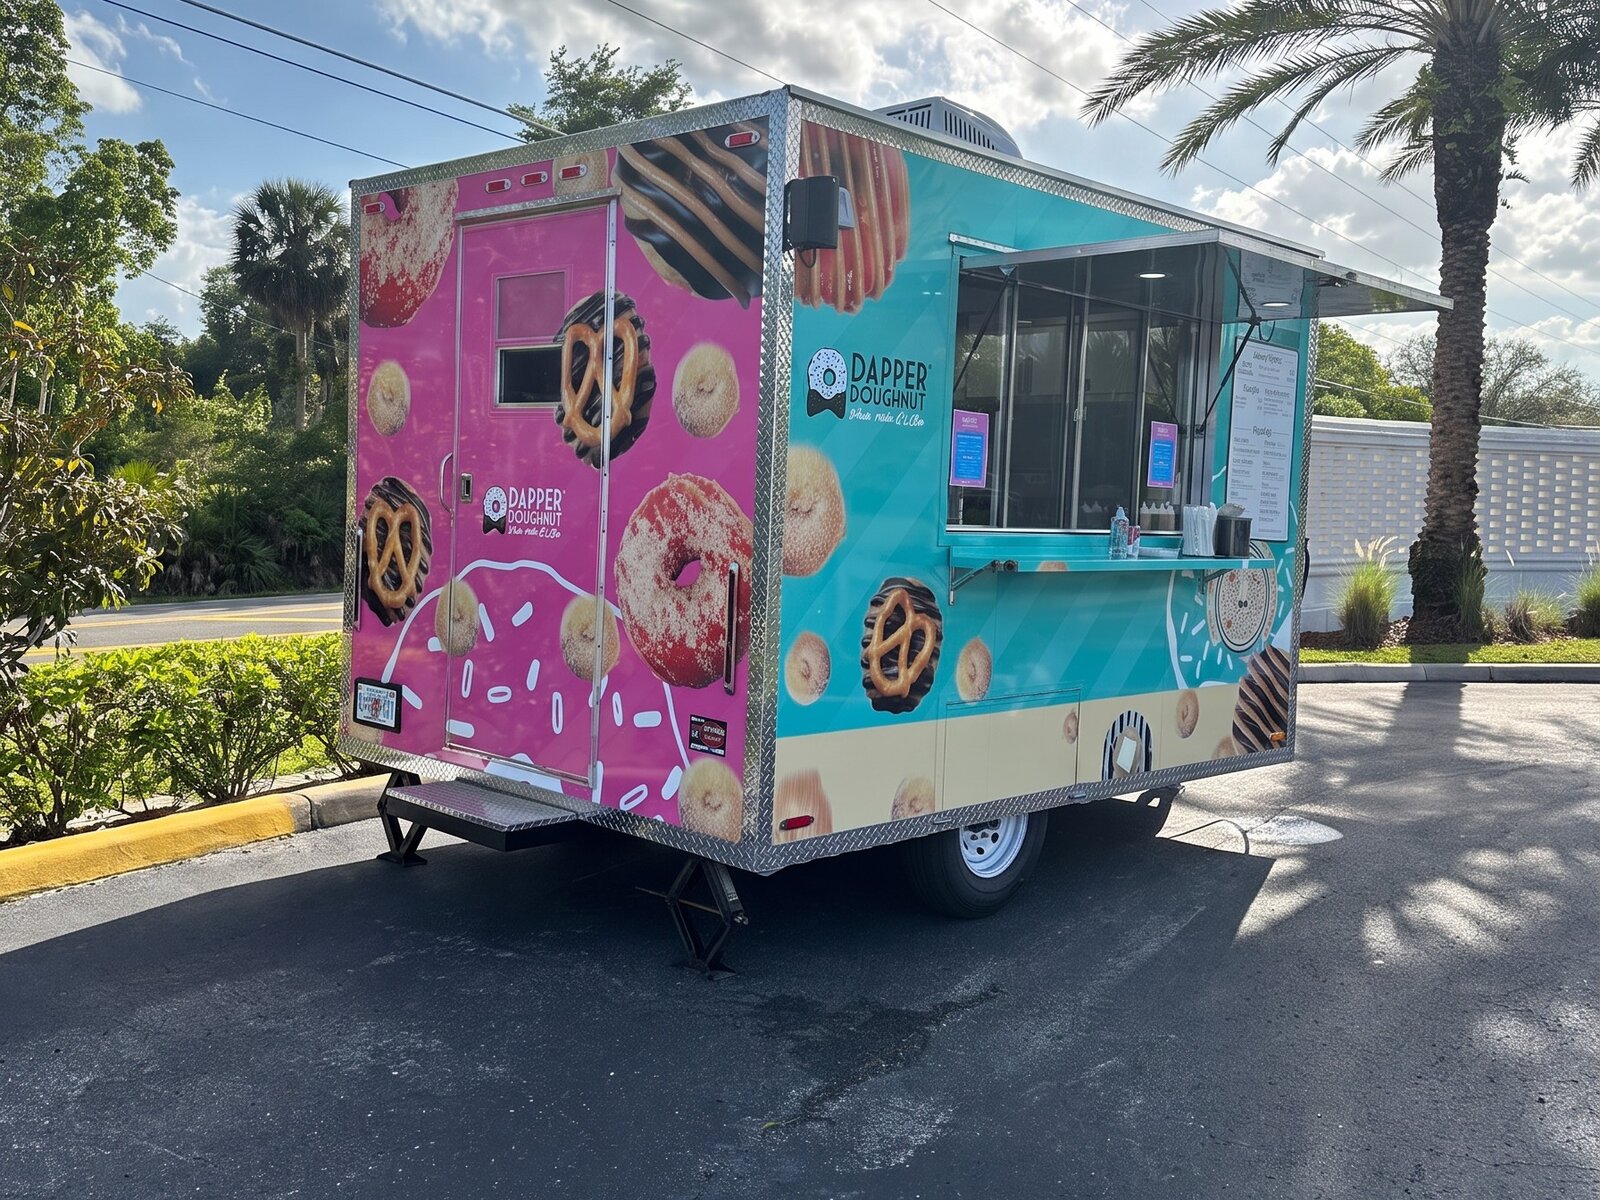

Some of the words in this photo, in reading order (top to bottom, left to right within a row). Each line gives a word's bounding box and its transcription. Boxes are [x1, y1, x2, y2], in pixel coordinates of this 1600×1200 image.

[851, 352, 927, 391] DAPPER
[850, 385, 926, 410] DOUGHNUT
[509, 486, 562, 511] DAPPER
[508, 510, 562, 526] DOUGHNUT
